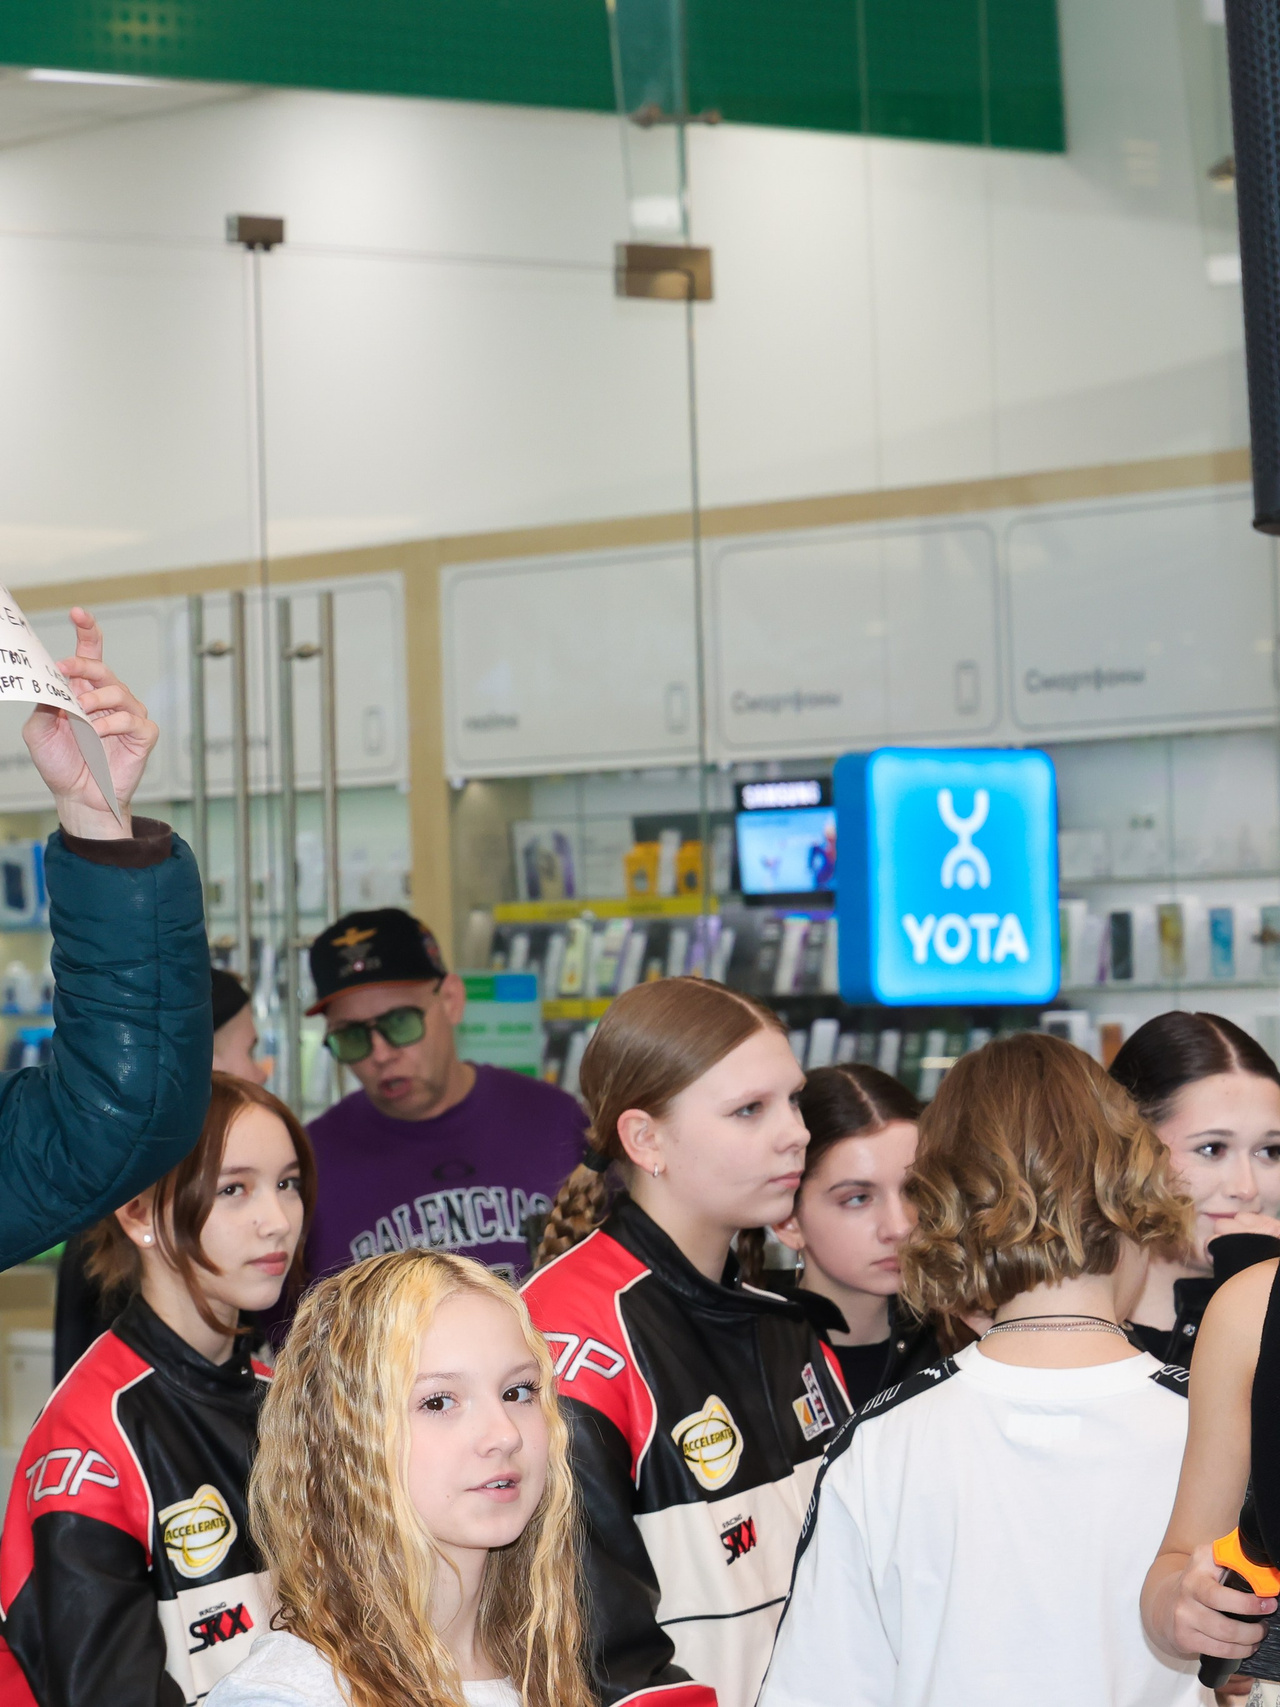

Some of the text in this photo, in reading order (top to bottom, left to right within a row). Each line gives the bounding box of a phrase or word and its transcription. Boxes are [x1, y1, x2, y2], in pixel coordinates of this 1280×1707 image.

[31, 679, 41, 694] В
[902, 912, 1030, 965] YOTA
[683, 1427, 733, 1454] ACCELERATE
[25, 1446, 120, 1514] TOP
[165, 1516, 227, 1542] ACCELERATE
[720, 1515, 756, 1566] SKX
[188, 1602, 249, 1655] SKX
